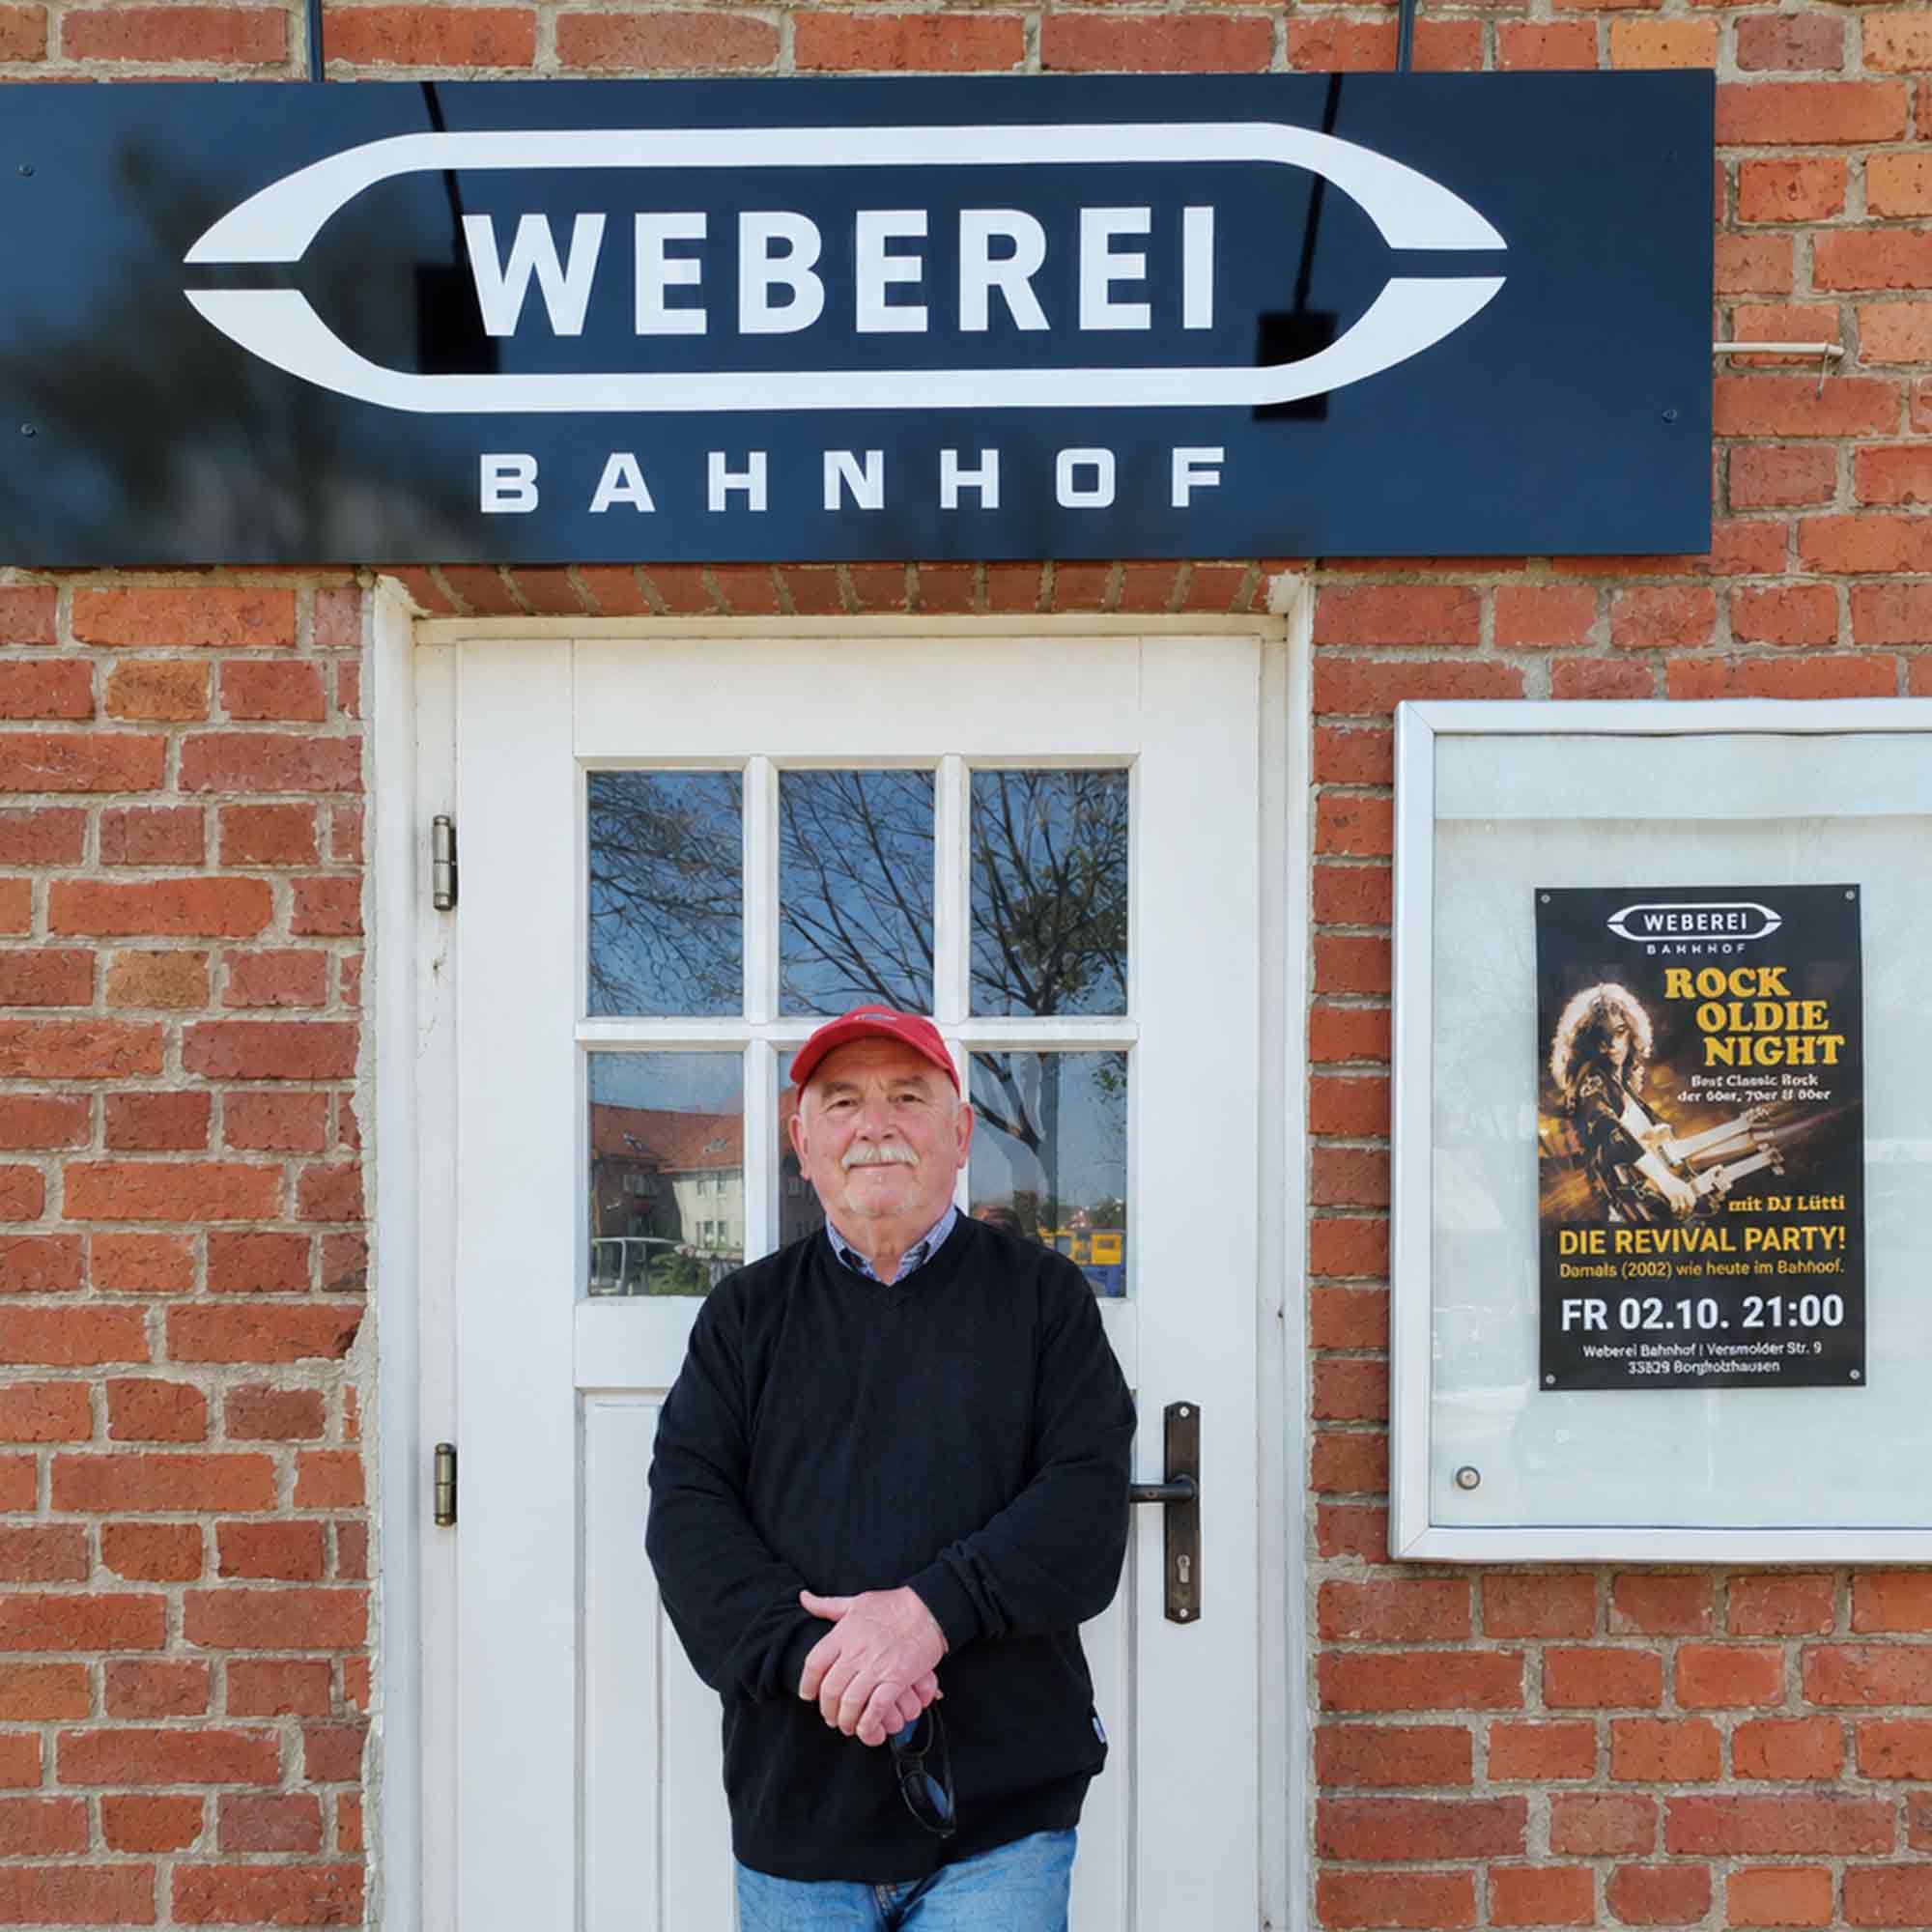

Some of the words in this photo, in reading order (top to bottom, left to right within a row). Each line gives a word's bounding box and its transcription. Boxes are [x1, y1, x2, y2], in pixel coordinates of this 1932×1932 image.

[462, 206, 1214, 336] WEBEREI
[479, 446, 1225, 513] BAHNHOF
[1644, 913, 1747, 931] WEBEREI
[1646, 943, 1746, 955] BAHNHOF
[1663, 967, 1791, 999] ROCK
[1696, 1000, 1829, 1033] OLDIE
[1703, 1035, 1846, 1066] NIGHT
[1691, 1075, 1723, 1087] Best
[1726, 1074, 1777, 1087] Classic
[1781, 1073, 1819, 1086] Rock
[1677, 1091, 1701, 1102] der
[1745, 1091, 1777, 1102] 70er
[1728, 1197, 1762, 1211] mit
[1767, 1196, 1792, 1212] DJ
[1798, 1194, 1845, 1211] Lütti
[1559, 1229, 1606, 1255] DIE
[1615, 1227, 1736, 1254] REVIVAL
[1745, 1226, 1846, 1252] PARTY!
[1560, 1263, 1617, 1278] Damals
[1622, 1262, 1672, 1280] (2002)
[1677, 1263, 1703, 1276] wie
[1707, 1261, 1749, 1275] heute
[1754, 1260, 1774, 1274] im
[1561, 1298, 1608, 1331] FR
[1619, 1297, 1730, 1330] 02.10.
[1742, 1294, 1845, 1328] 21:00
[1583, 1344, 1637, 1357] Weberei
[1641, 1343, 1696, 1356] Bahnhof
[1787, 1341, 1811, 1354] Str.
[1813, 1341, 1823, 1353] 9
